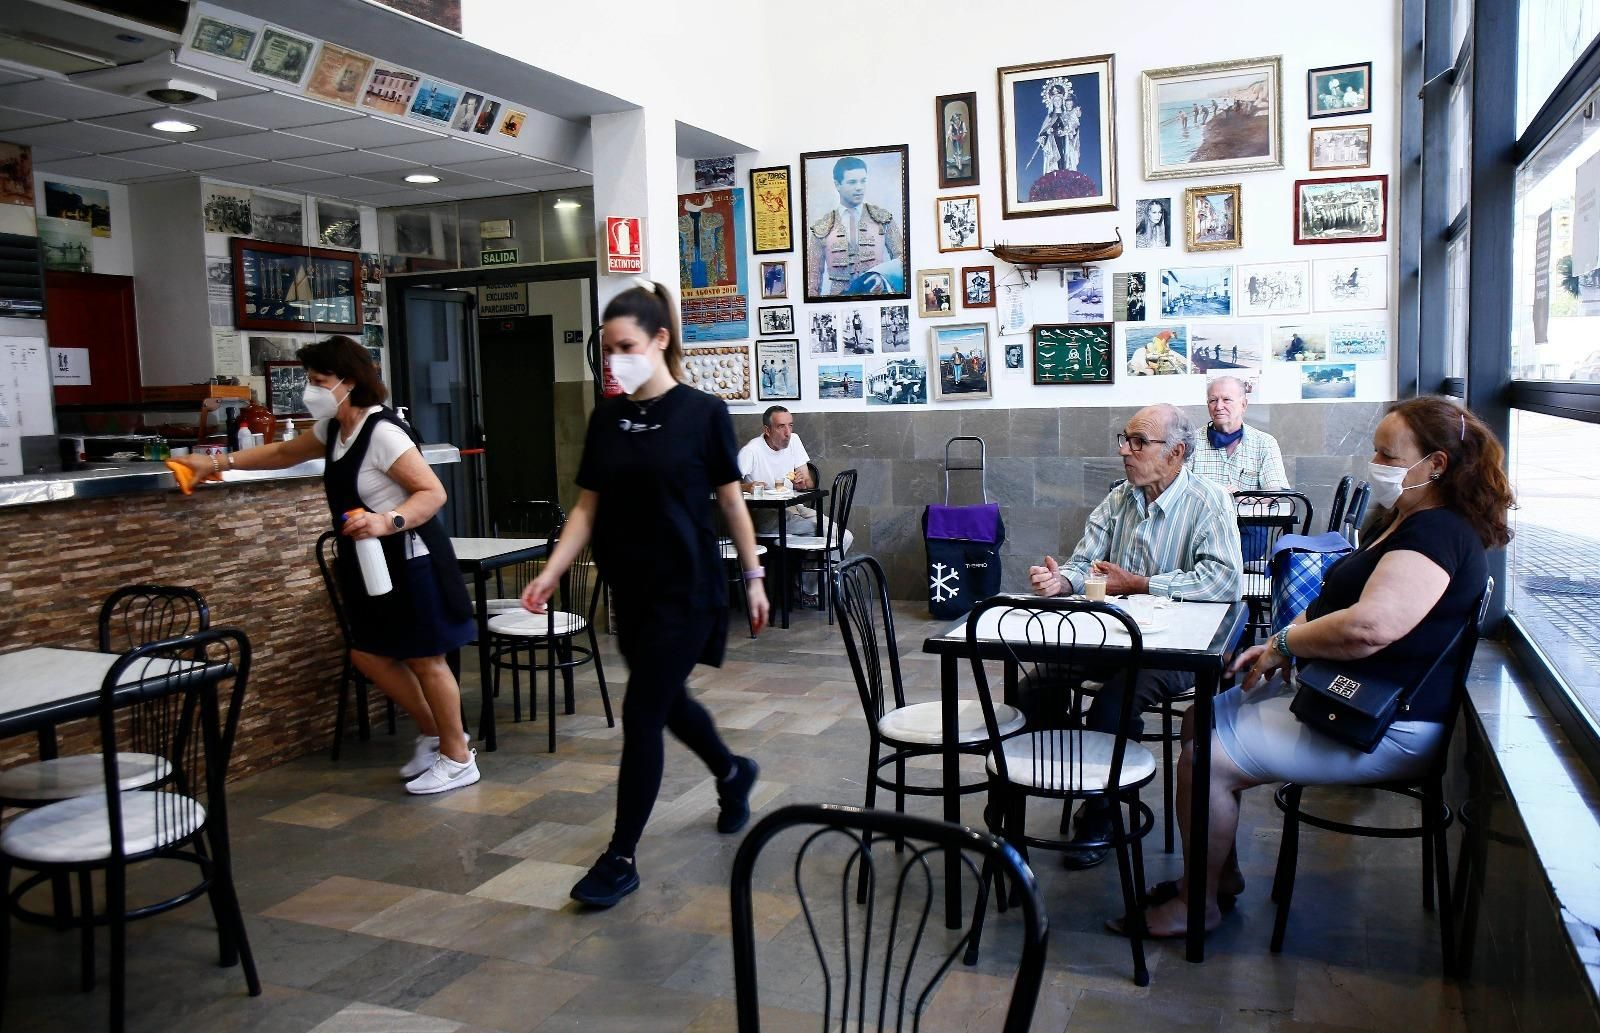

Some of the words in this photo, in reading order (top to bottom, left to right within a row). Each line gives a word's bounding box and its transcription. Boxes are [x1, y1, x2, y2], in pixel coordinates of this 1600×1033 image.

[483, 251, 516, 263] SALIDA
[610, 259, 640, 269] EXTINTOR
[486, 291, 519, 301] EXCLUSIVO
[696, 288, 721, 296] AGOSTO
[480, 303, 526, 314] APARCAMIENTO
